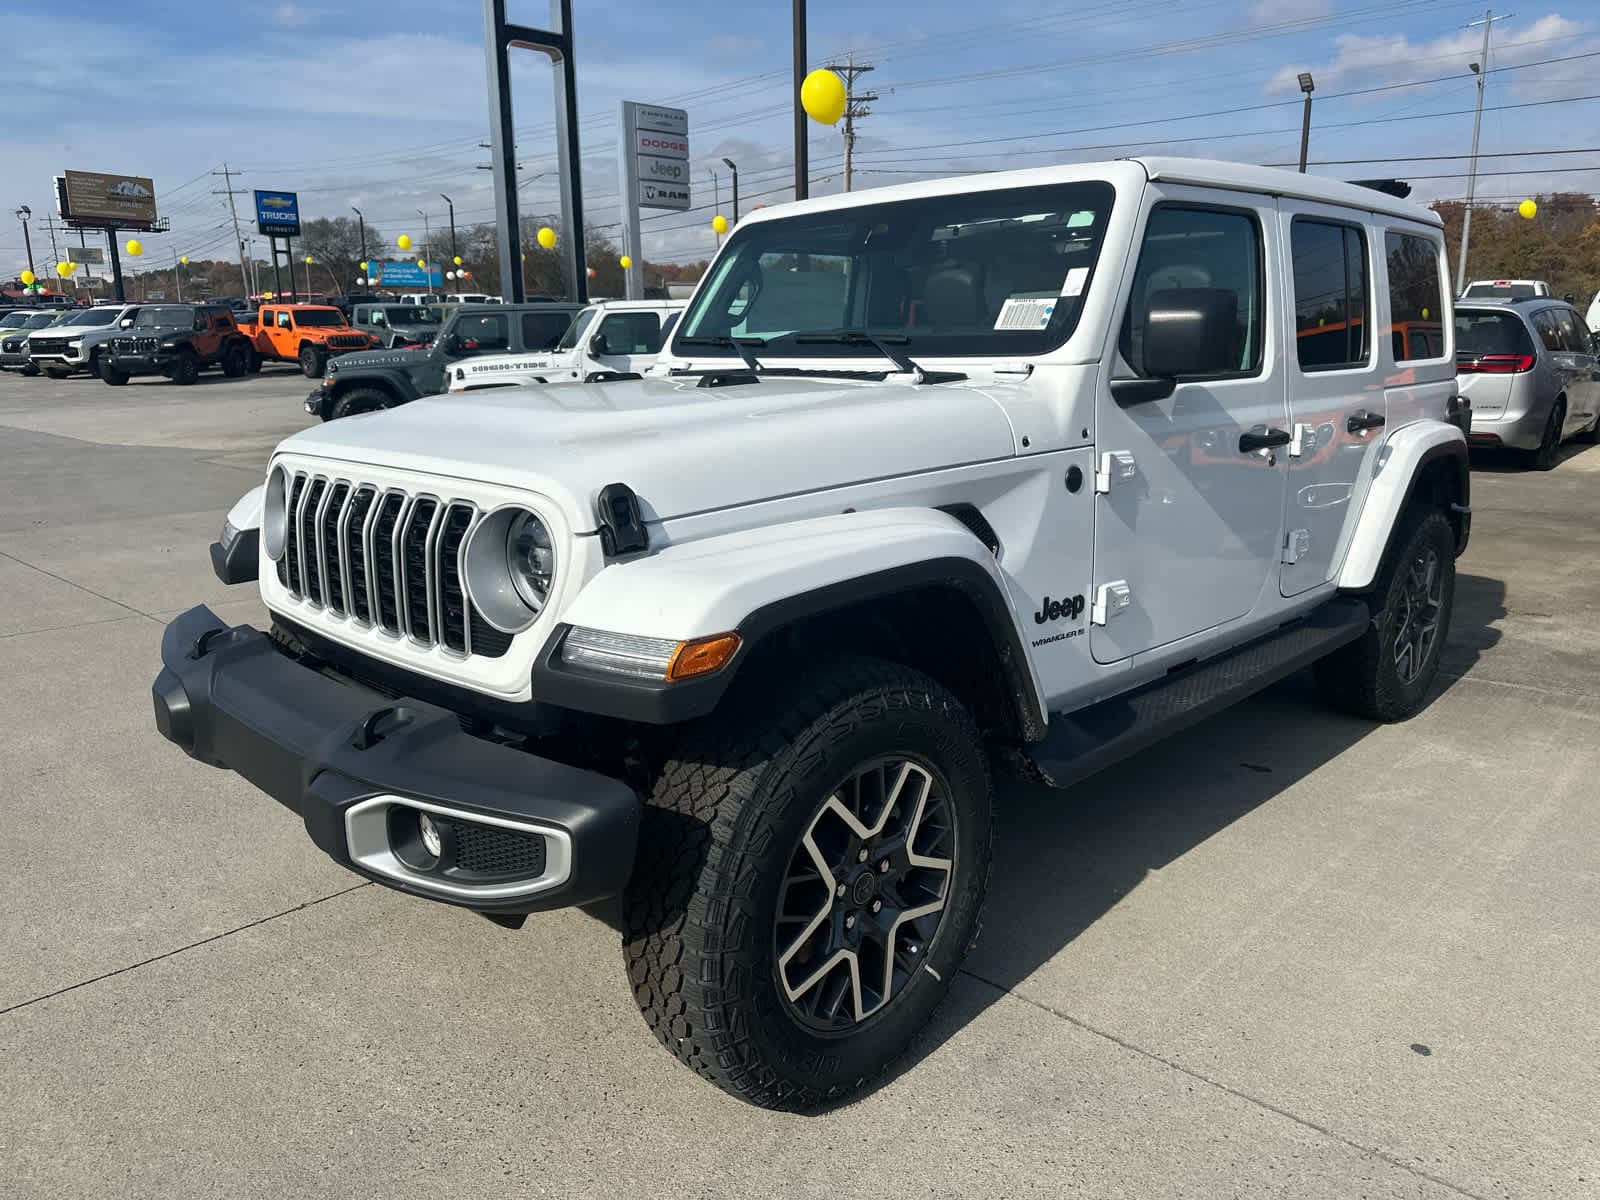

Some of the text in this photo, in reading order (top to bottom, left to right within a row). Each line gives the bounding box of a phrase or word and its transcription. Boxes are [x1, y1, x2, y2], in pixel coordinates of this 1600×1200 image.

[641, 110, 685, 120] CHRYSLER
[641, 138, 686, 151] DODGE
[650, 160, 681, 178] Jeep
[658, 190, 688, 200] RAM
[261, 211, 297, 220] TRUCKS
[1034, 594, 1085, 624] Jeep
[1032, 630, 1077, 648] WRANGLER
